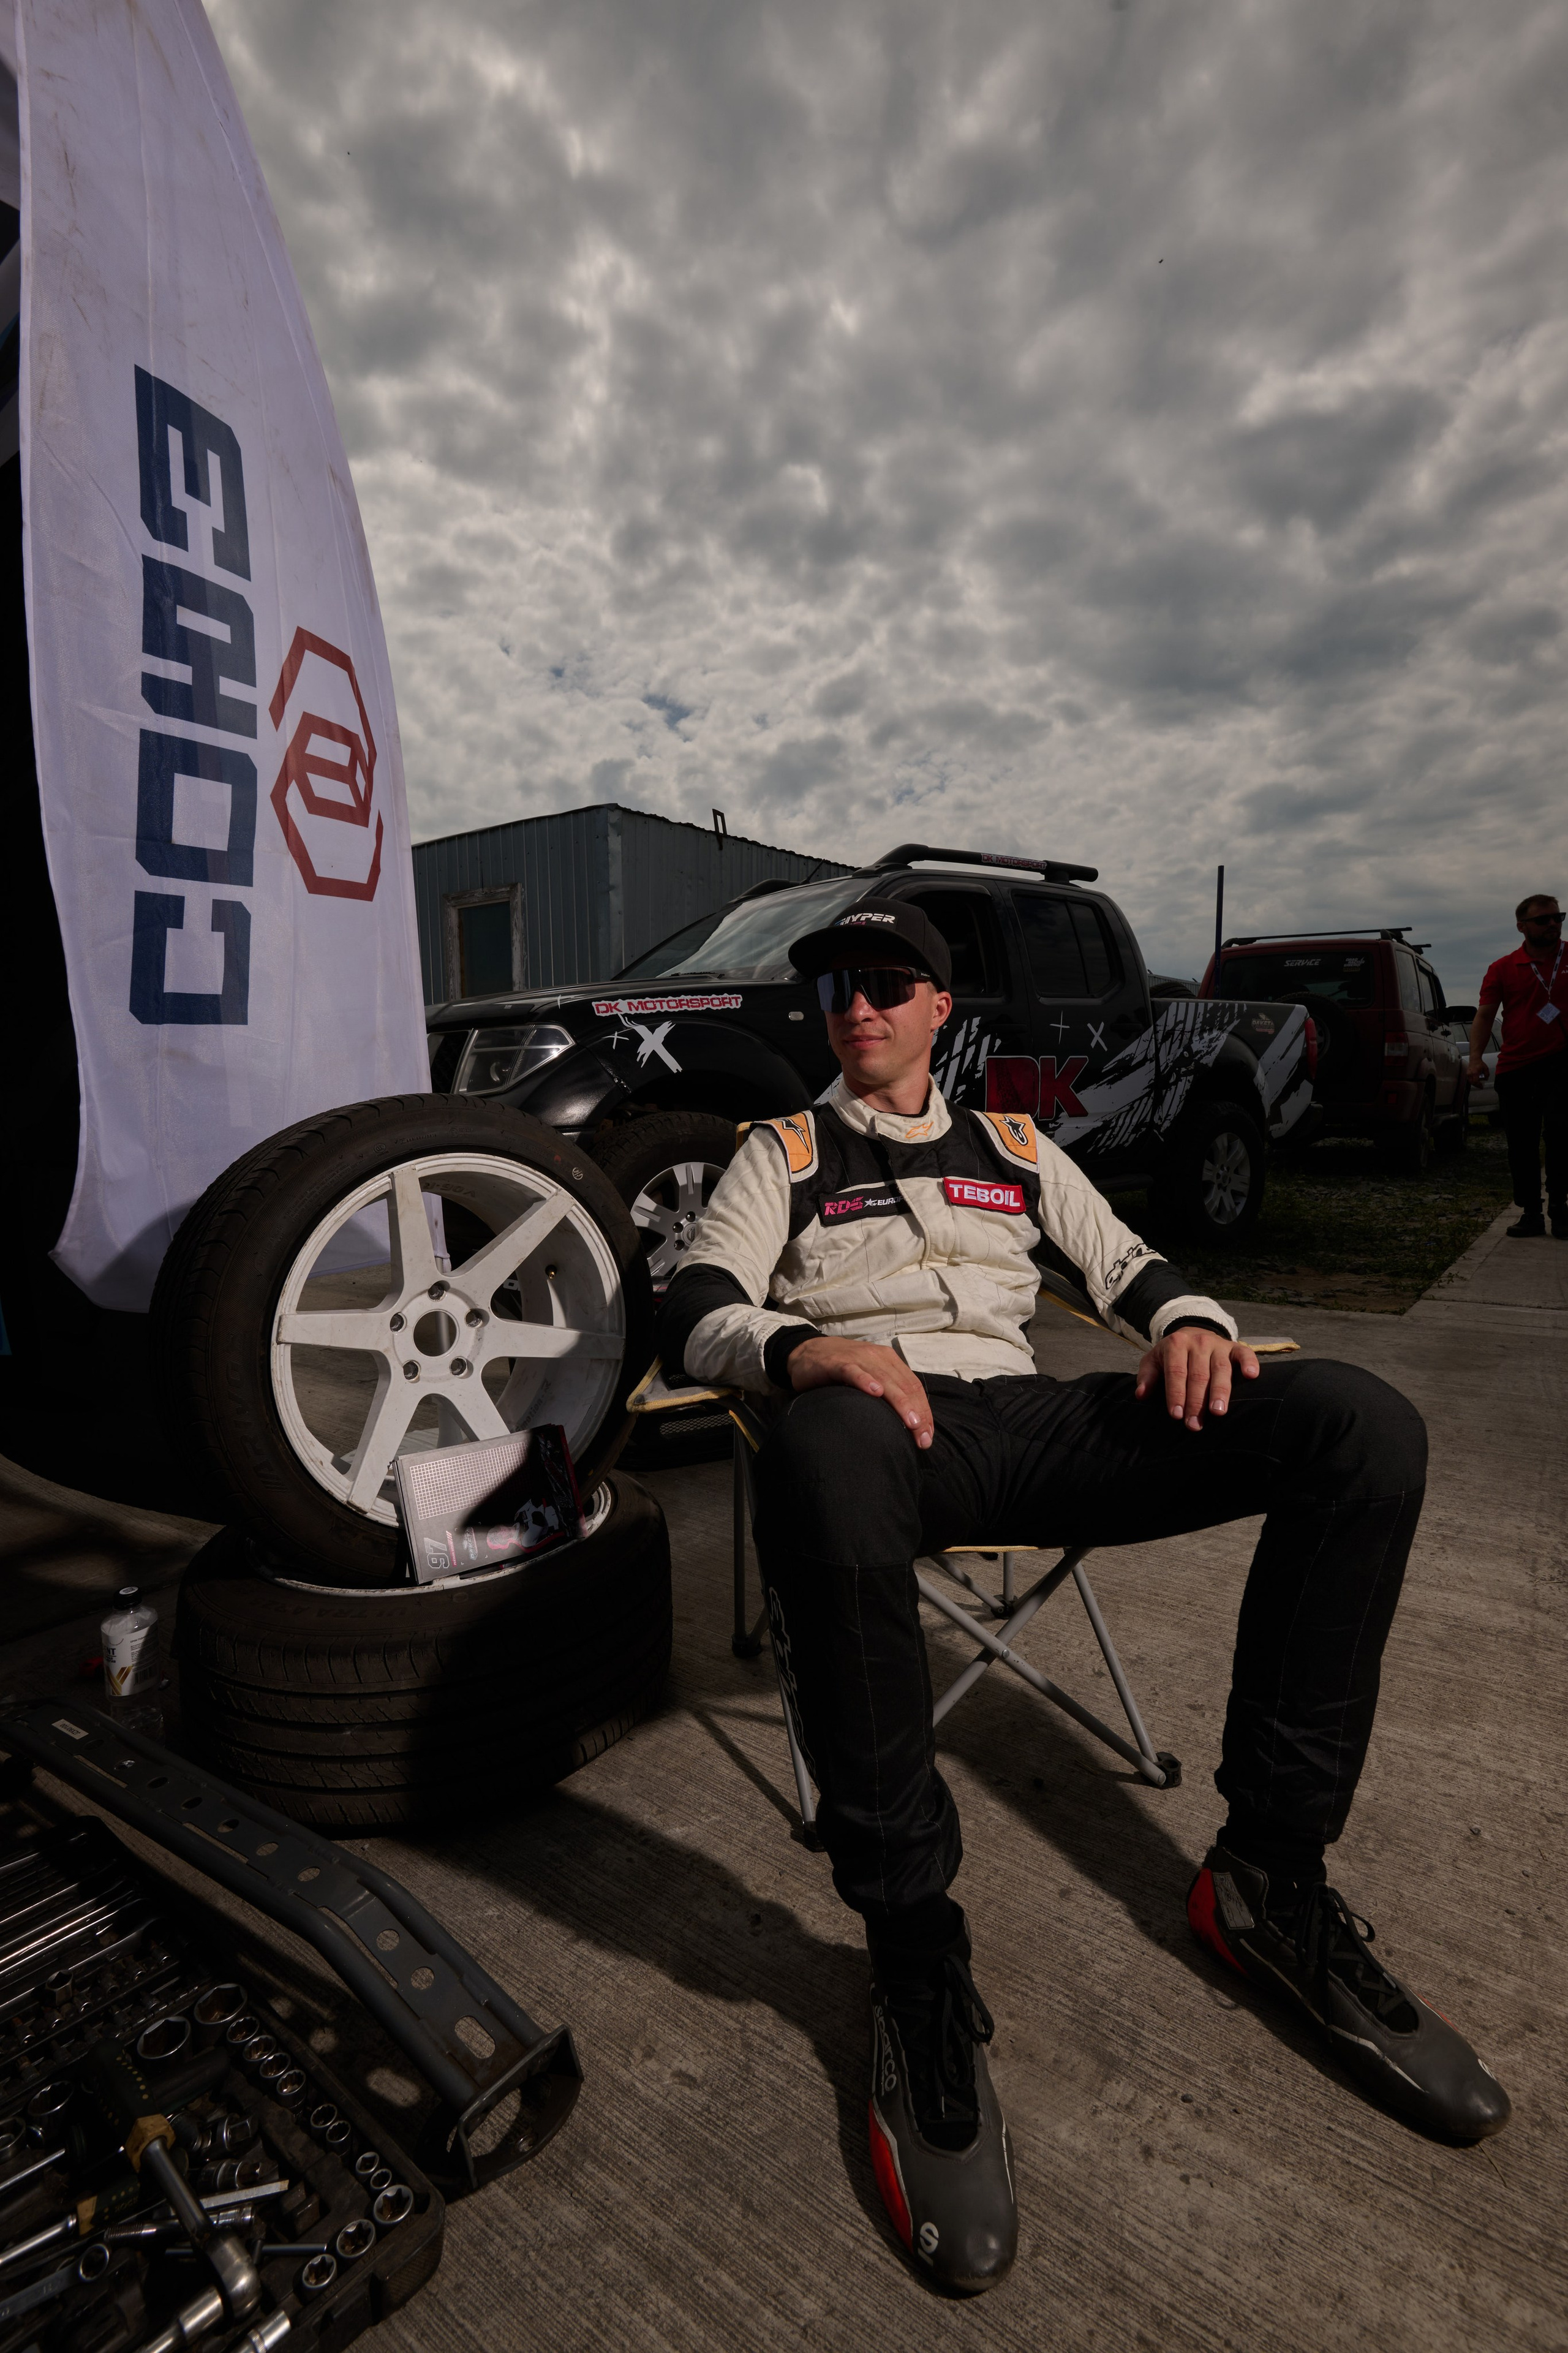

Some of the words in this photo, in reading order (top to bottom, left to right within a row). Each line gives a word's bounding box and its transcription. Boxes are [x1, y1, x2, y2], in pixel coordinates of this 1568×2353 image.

[129, 364, 257, 1026] СОЮЗ
[996, 856, 1046, 869] MOTORSPORT
[838, 912, 895, 926] HYPER
[594, 1002, 623, 1014] DK
[627, 996, 741, 1012] MOTORSPORT
[985, 1055, 1089, 1120] DK
[824, 1196, 864, 1216] RDS
[949, 1184, 1020, 1207] TEBOIL
[423, 1537, 450, 1569] 97
